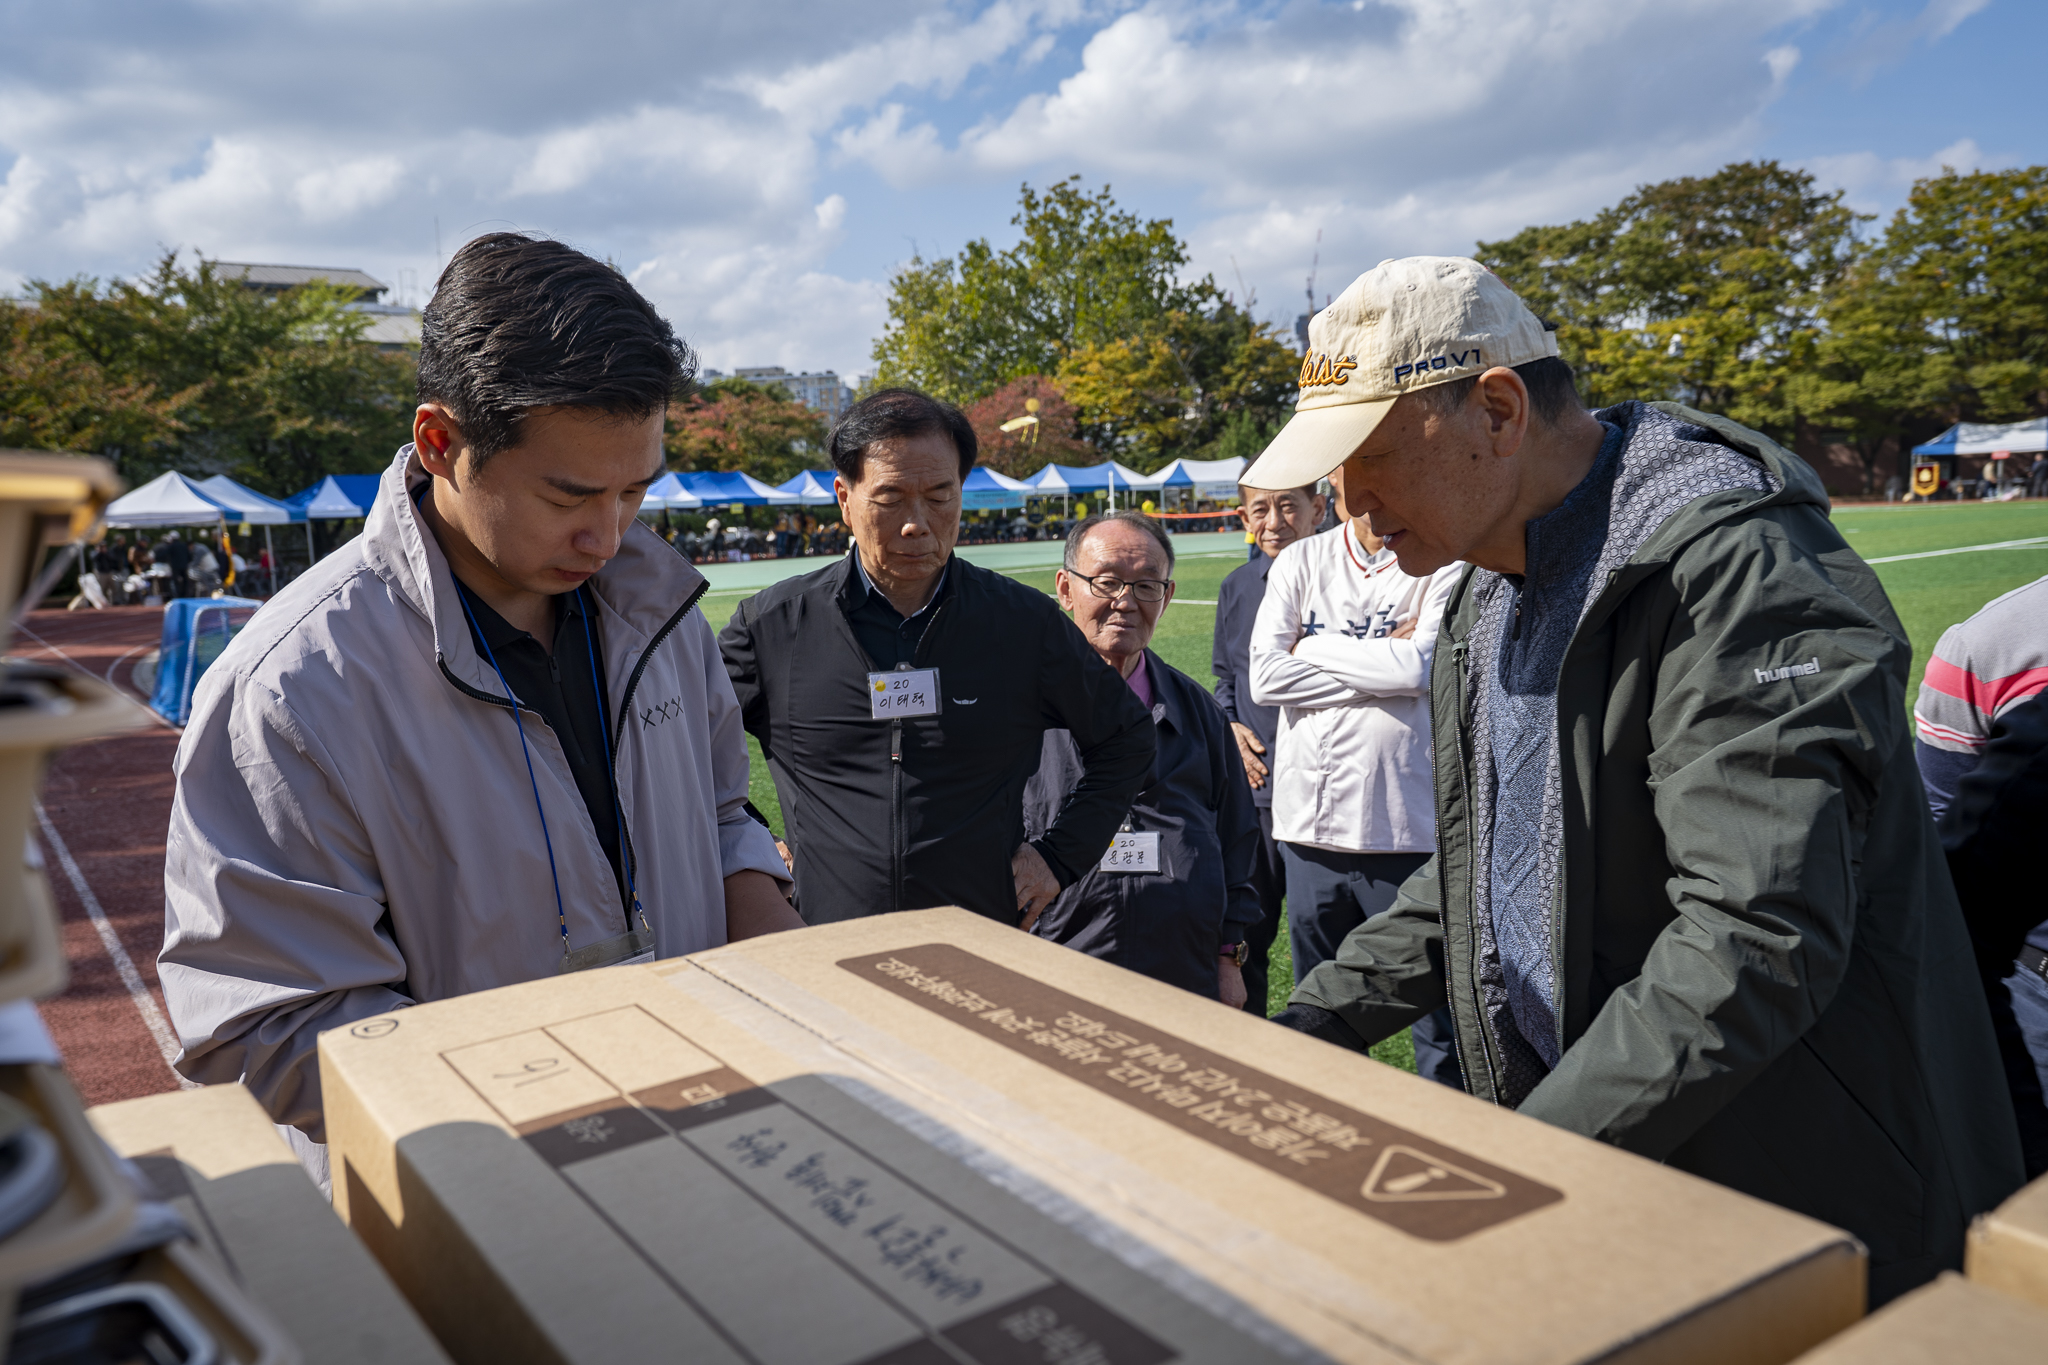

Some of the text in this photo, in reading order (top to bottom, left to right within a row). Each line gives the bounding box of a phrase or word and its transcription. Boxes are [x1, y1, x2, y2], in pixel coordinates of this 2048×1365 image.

[1298, 346, 1358, 389] leist
[1394, 348, 1481, 383] PRO V1
[893, 679, 910, 690] 20
[1754, 656, 1821, 684] hummel
[1120, 840, 1135, 848] 20
[978, 1007, 1046, 1034] 곳에
[1025, 1027, 1113, 1065] 서늘한
[1054, 1010, 1373, 1152] 제품은 2시간 이내 드세요
[562, 1114, 617, 1144] 수량
[1188, 1100, 1331, 1165] 기울이지
